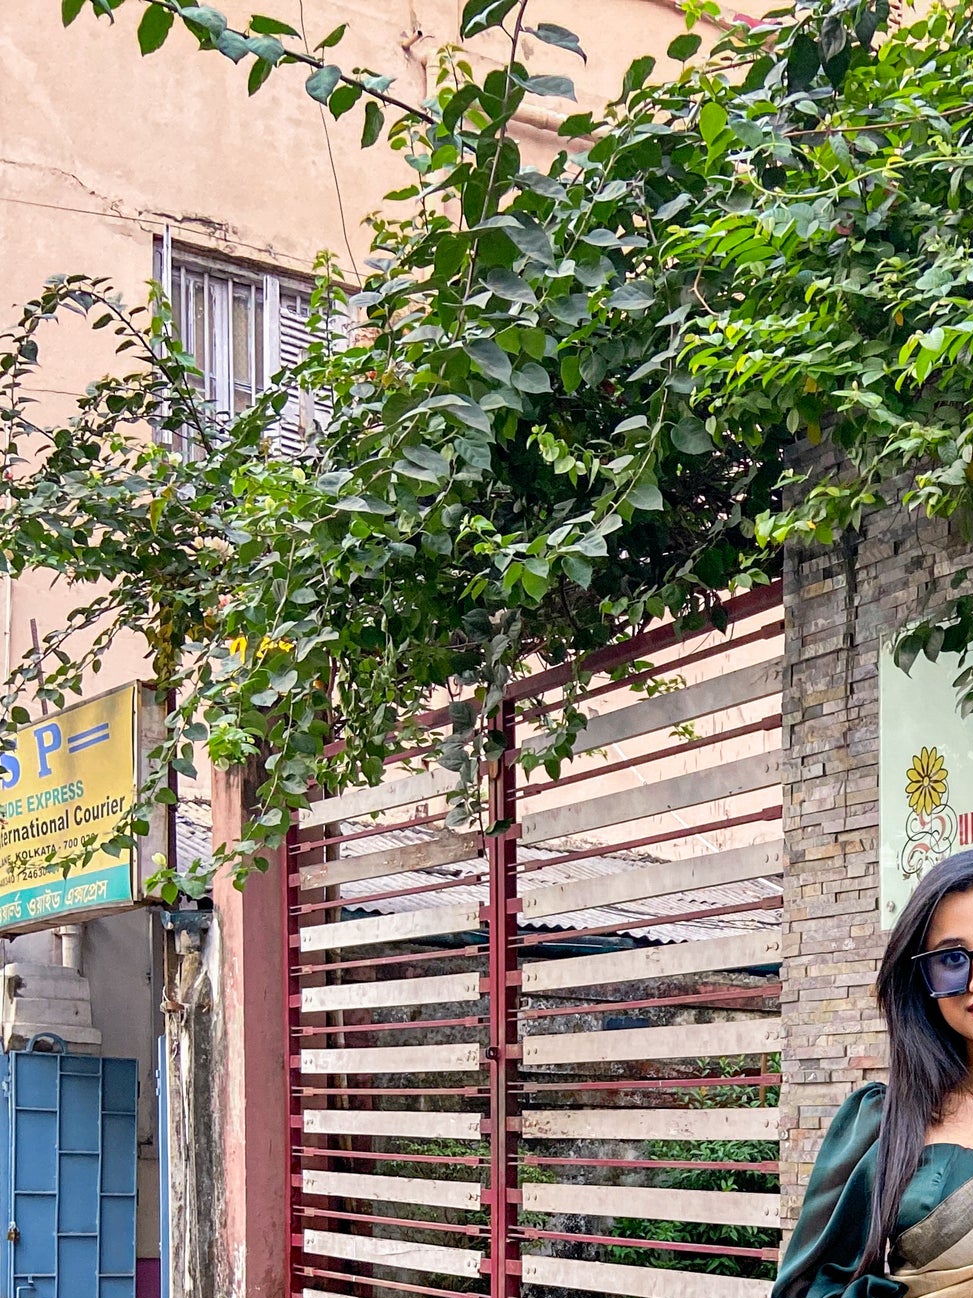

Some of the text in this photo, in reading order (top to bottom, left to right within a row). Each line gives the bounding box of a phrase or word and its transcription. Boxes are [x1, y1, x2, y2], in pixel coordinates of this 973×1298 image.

[0, 780, 84, 818] IDE EXPRESS
[74, 796, 125, 826] Courier
[15, 845, 56, 862] KOLKATA
[64, 837, 79, 850] 700
